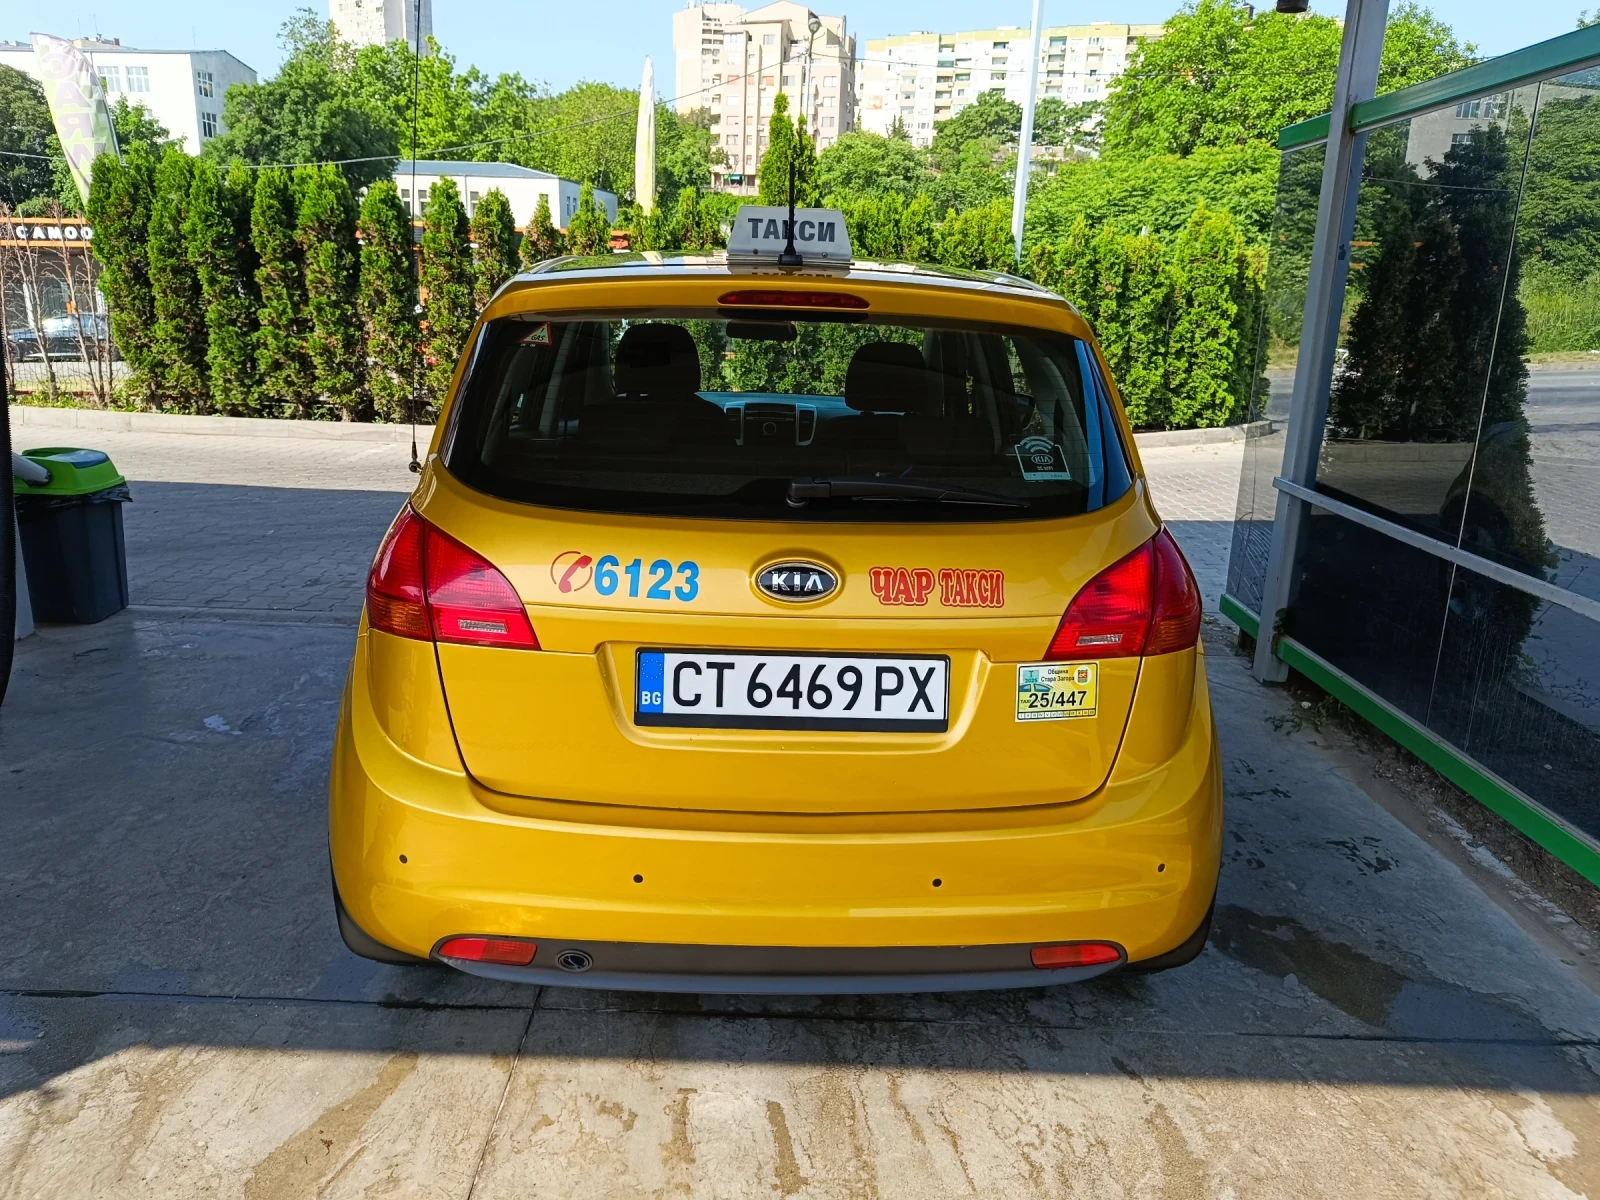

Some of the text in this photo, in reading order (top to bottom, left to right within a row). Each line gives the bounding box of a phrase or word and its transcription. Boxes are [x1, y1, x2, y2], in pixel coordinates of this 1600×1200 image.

[748, 218, 836, 243] ТАКСИ
[531, 334, 546, 342] GAS
[1034, 455, 1051, 463] KIA
[594, 554, 700, 603] 6123
[771, 570, 825, 592] KIA
[868, 566, 1005, 608] ЧАР ТАКСИ
[1047, 668, 1069, 676] Община
[746, 662, 863, 711] 6469
[641, 690, 662, 706] BG
[1028, 690, 1087, 709] 25/447
